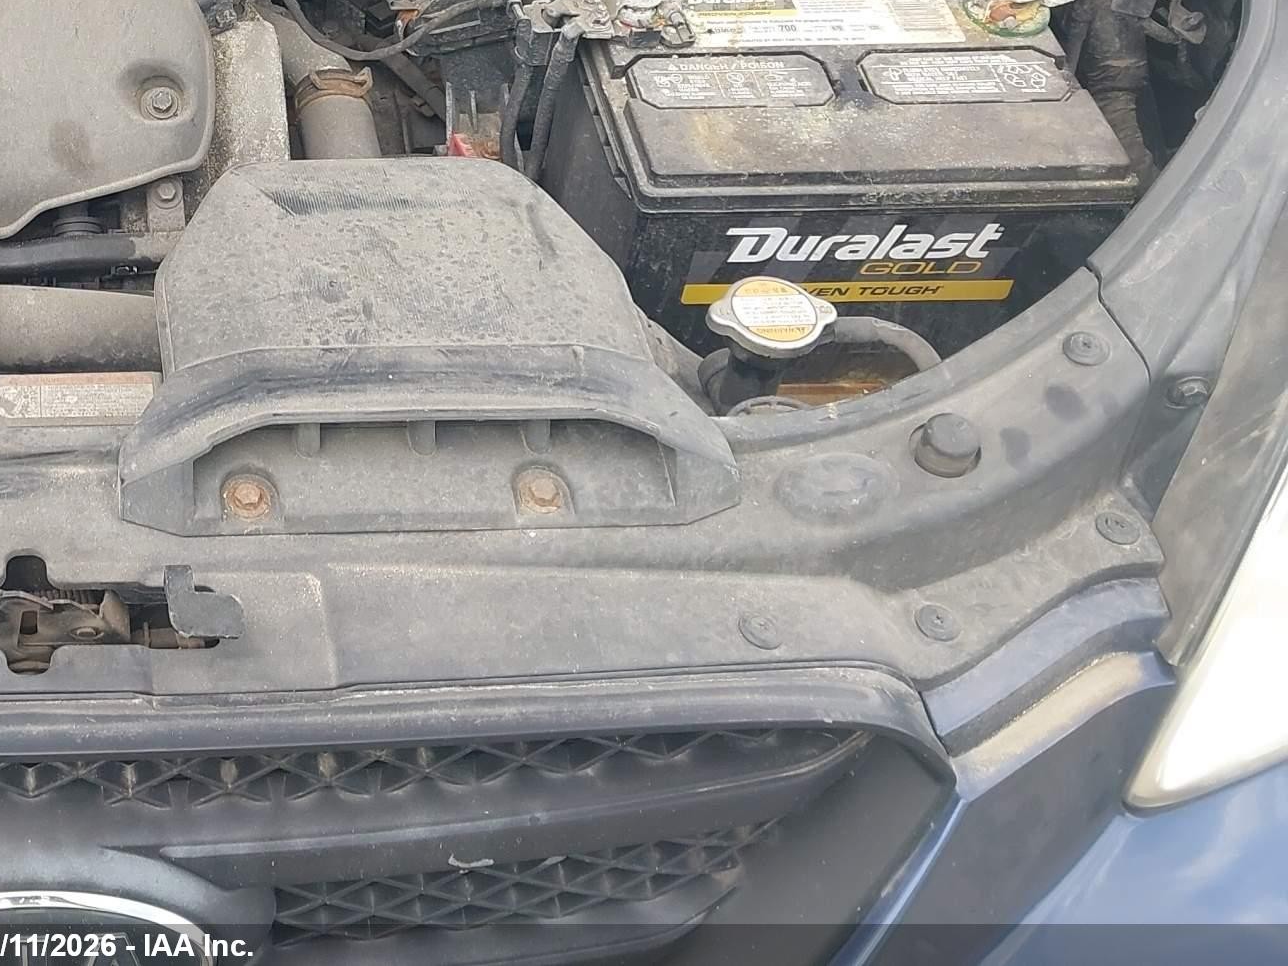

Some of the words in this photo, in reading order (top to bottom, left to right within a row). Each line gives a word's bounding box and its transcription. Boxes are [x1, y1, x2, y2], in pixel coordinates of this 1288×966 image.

[778, 24, 797, 32] 700
[679, 63, 727, 72] DANGER
[740, 60, 785, 71] POISON
[726, 223, 1002, 264] Duralast
[859, 261, 982, 275] GOLD
[804, 286, 850, 298] VEN
[859, 286, 941, 297] TOUGH
